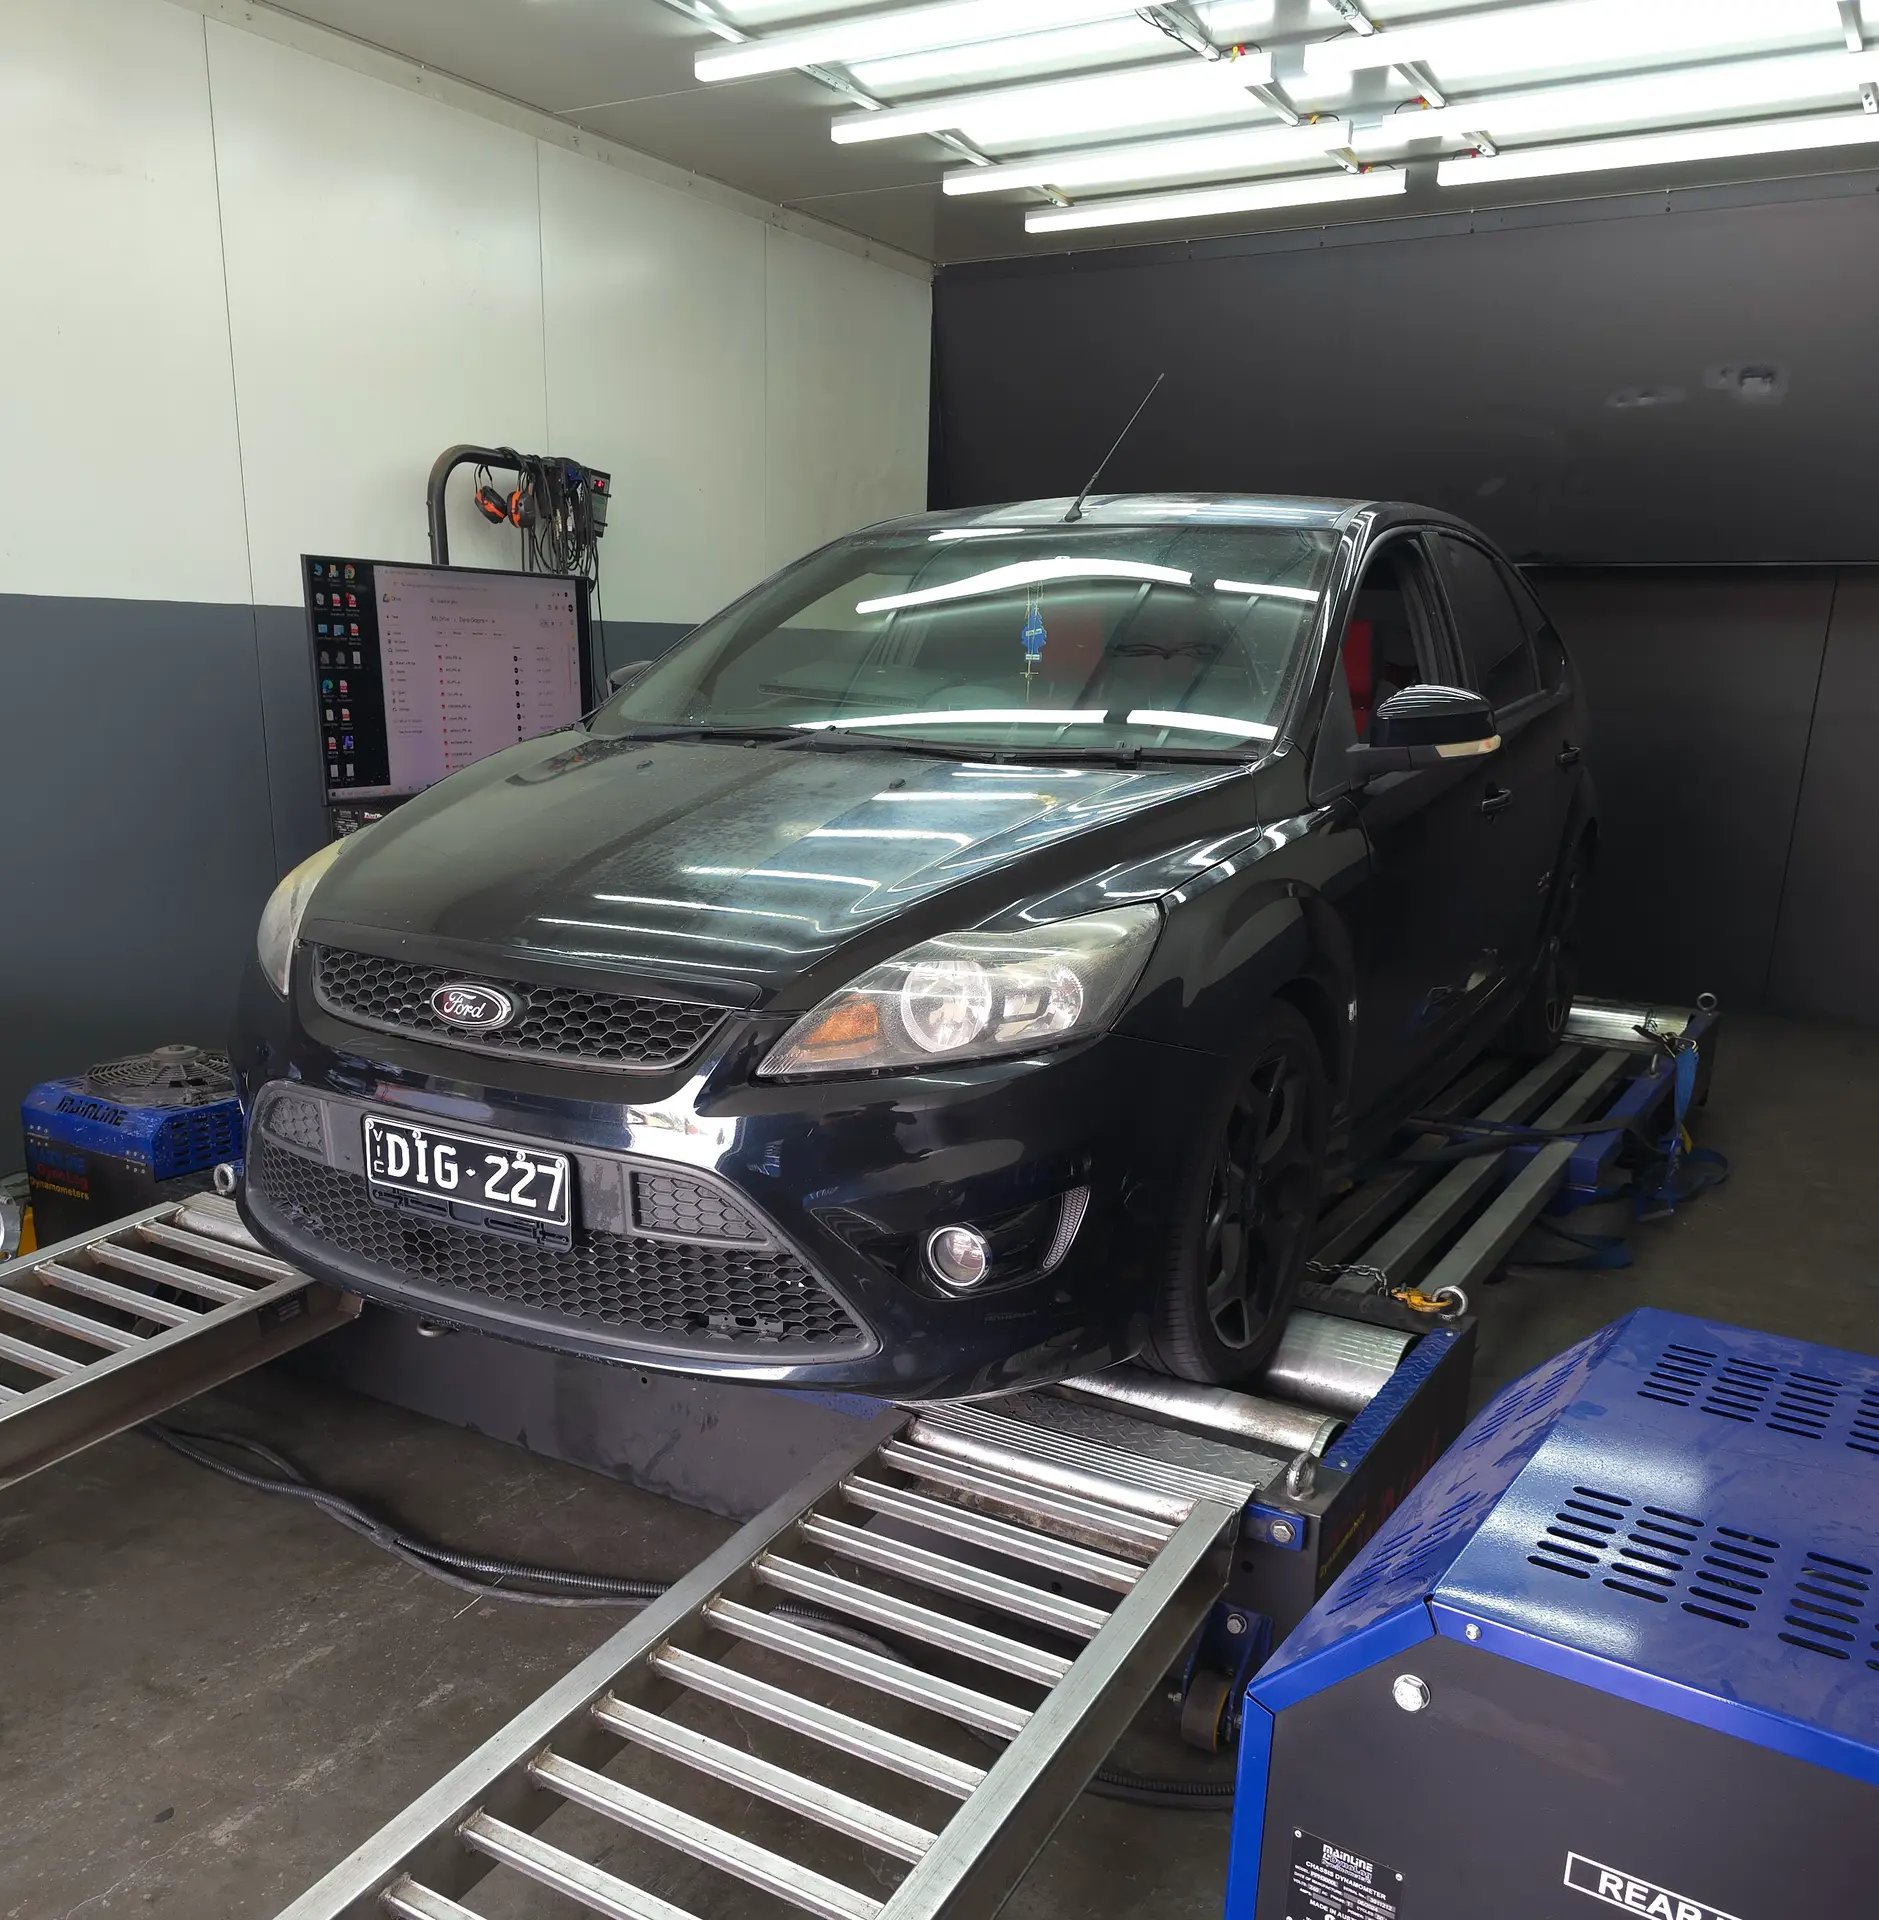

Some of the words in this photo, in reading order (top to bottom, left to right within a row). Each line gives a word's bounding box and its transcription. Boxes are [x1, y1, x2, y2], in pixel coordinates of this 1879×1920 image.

[444, 990, 487, 1020] Ford
[373, 1128, 385, 1174] VIC
[1306, 1861, 1334, 1877] CHASSIS
[1335, 1874, 1386, 1900] DYNAMOMETER
[1310, 1900, 1328, 1912] MADE
[1330, 1908, 1337, 1916] IN
